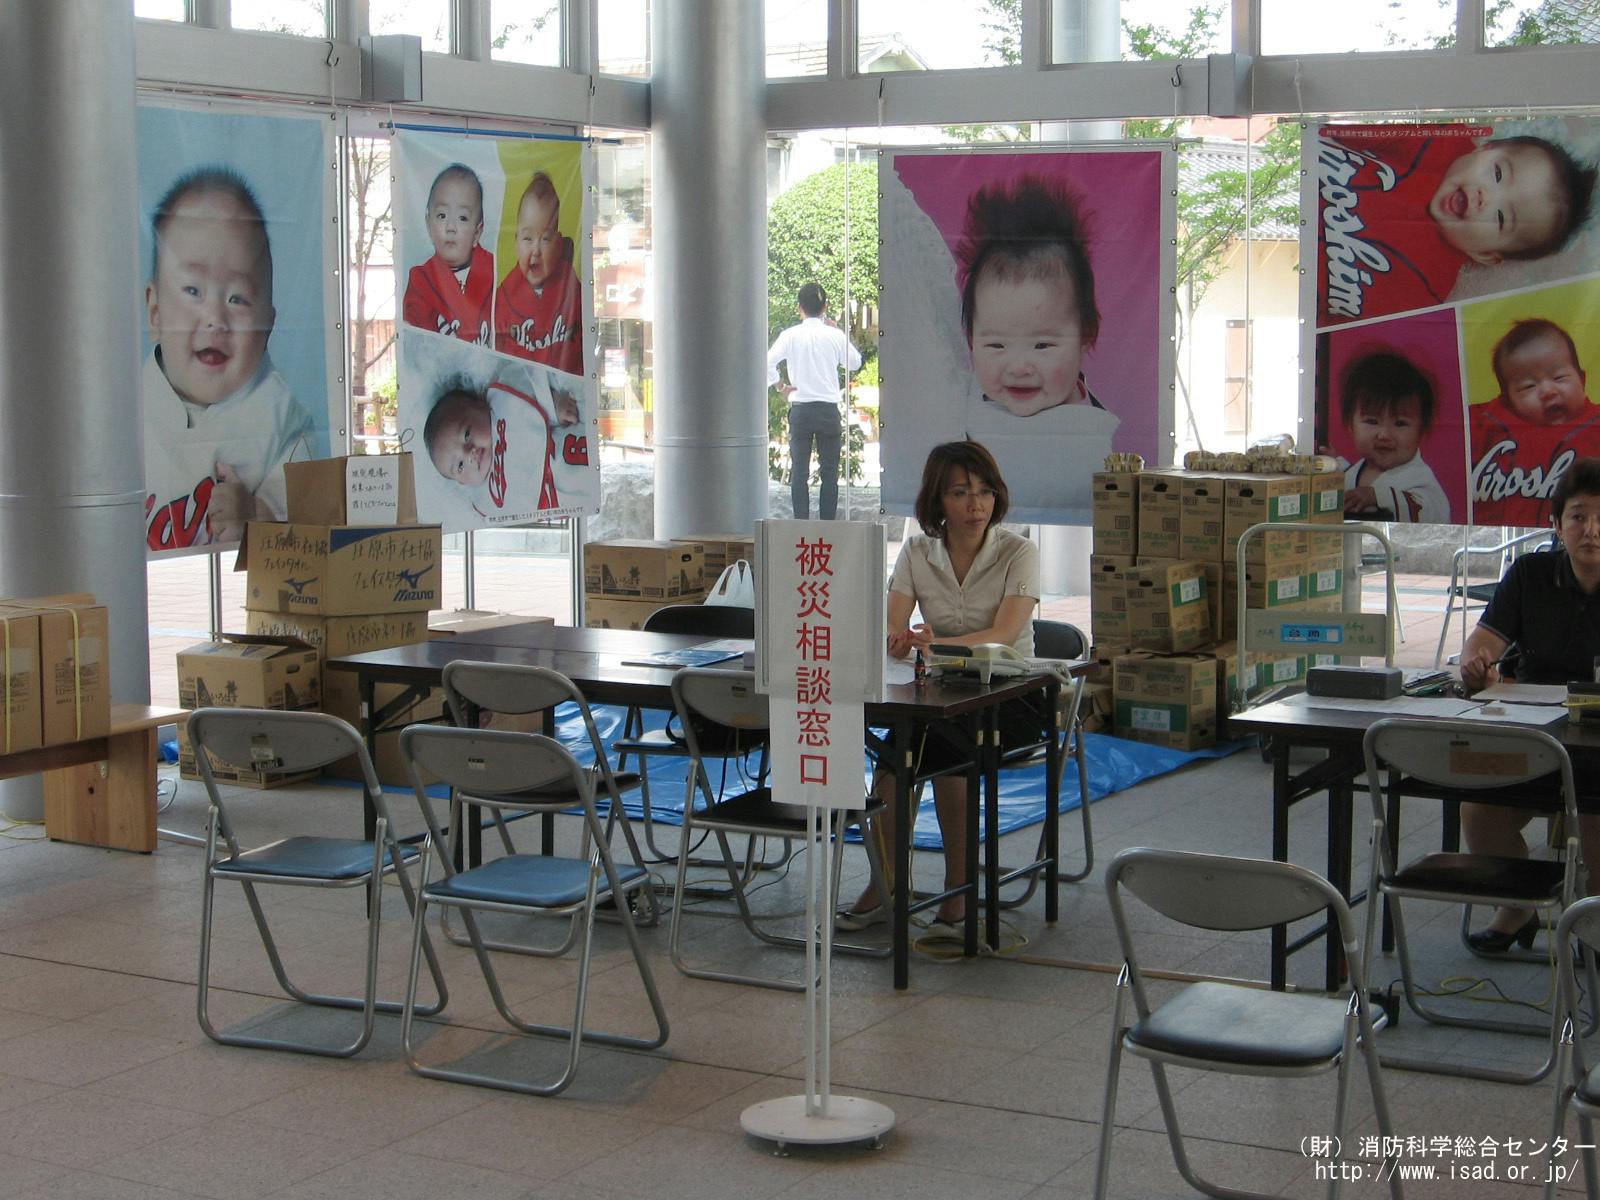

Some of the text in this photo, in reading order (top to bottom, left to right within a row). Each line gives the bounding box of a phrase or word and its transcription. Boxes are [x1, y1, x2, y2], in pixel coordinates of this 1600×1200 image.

[795, 537, 834, 786] 被災相談窓口
